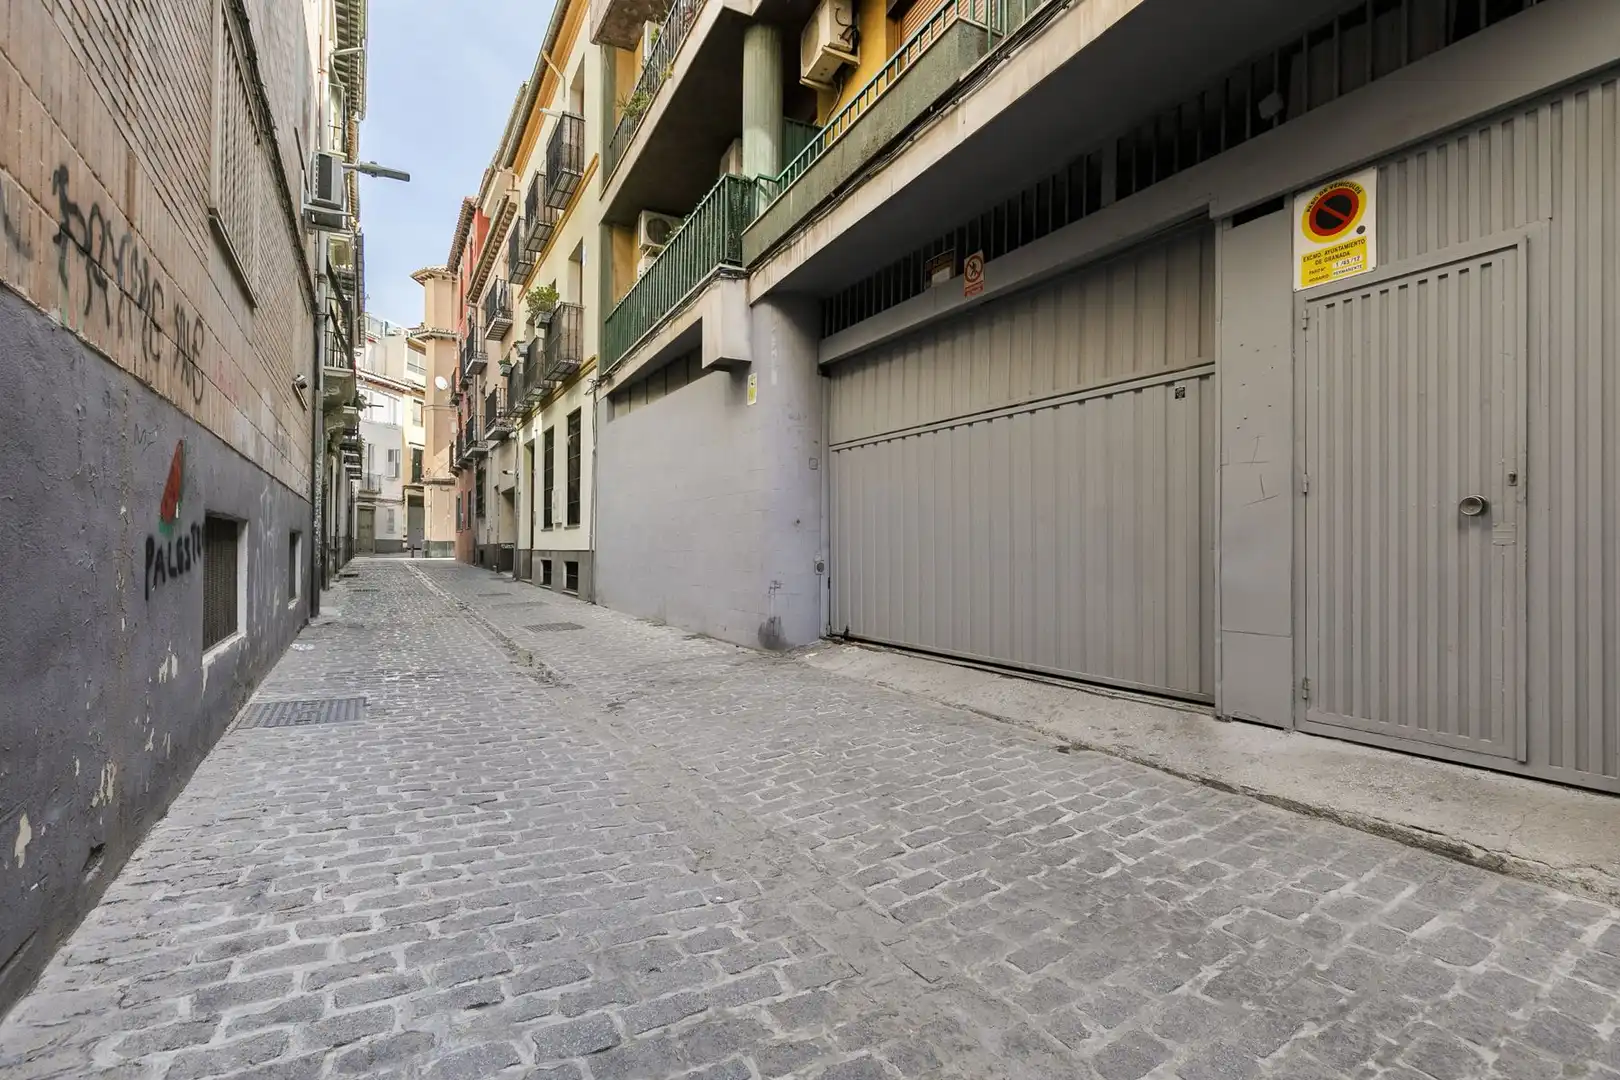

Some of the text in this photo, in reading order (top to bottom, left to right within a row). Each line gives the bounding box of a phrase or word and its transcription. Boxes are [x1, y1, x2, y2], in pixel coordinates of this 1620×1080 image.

[1324, 238, 1366, 255] AYUNTAMIENTO
[1315, 251, 1350, 266] DE GRANADA
[1333, 264, 1362, 276] PERMANENTE
